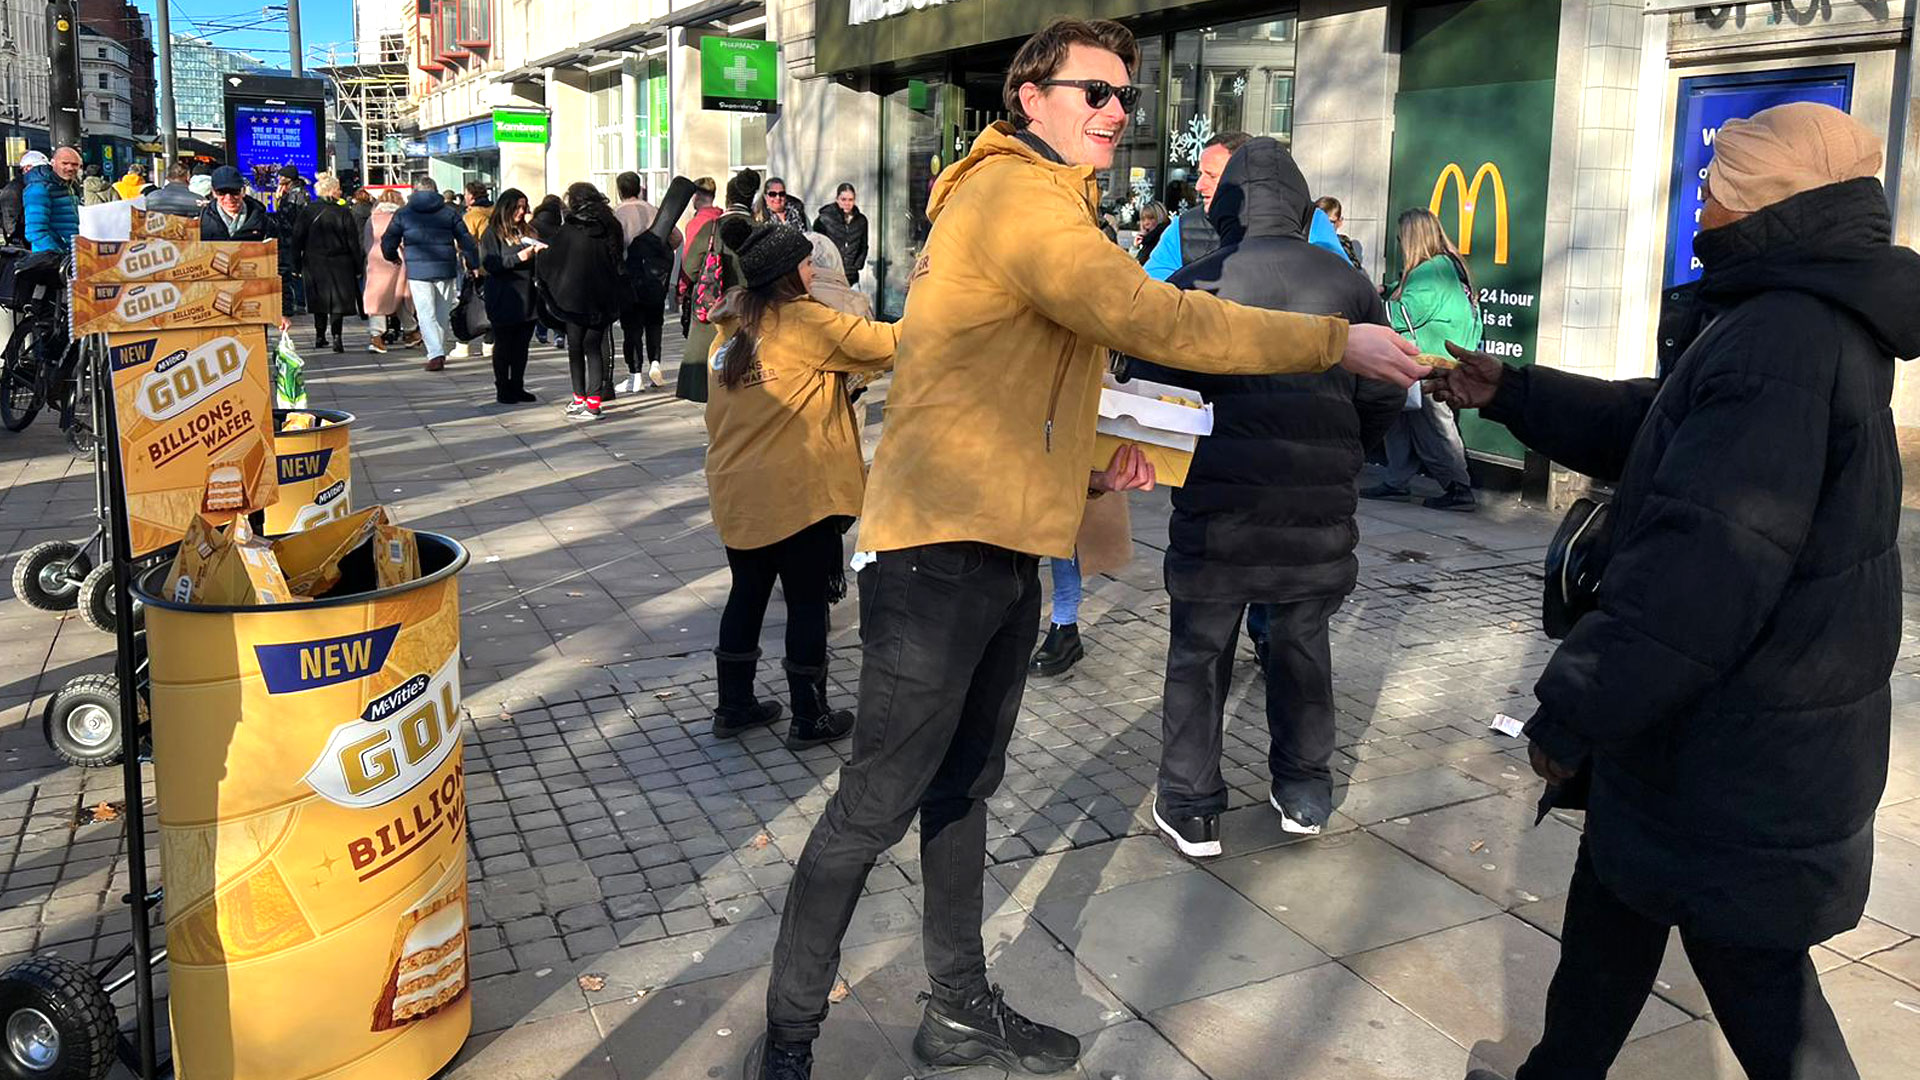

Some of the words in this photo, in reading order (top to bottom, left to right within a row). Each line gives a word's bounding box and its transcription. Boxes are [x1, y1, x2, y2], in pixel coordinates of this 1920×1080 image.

[720, 41, 760, 50] PHARMACY
[147, 215, 165, 231] GOLD
[98, 242, 117, 254] NEW
[125, 246, 175, 274] GOLD
[172, 264, 204, 277] BILLIONS
[191, 269, 210, 279] WAFER
[96, 286, 115, 299] NEW
[123, 288, 175, 317] GOLD
[1480, 288, 1497, 303] 24
[1500, 289, 1534, 307] hour
[172, 305, 205, 319] BILLIONS
[192, 311, 212, 321] WAFER
[1483, 309, 1496, 325] is
[1497, 312, 1513, 327] at
[119, 345, 147, 365] NEW
[147, 342, 241, 414] GOLD
[147, 399, 233, 463] BILLIONS
[201, 409, 253, 449] WAFER
[281, 454, 320, 478] NEW
[300, 637, 373, 680] NEW
[371, 675, 426, 720] McVitie's
[339, 680, 461, 797] GOL
[347, 764, 463, 871] BILLION
